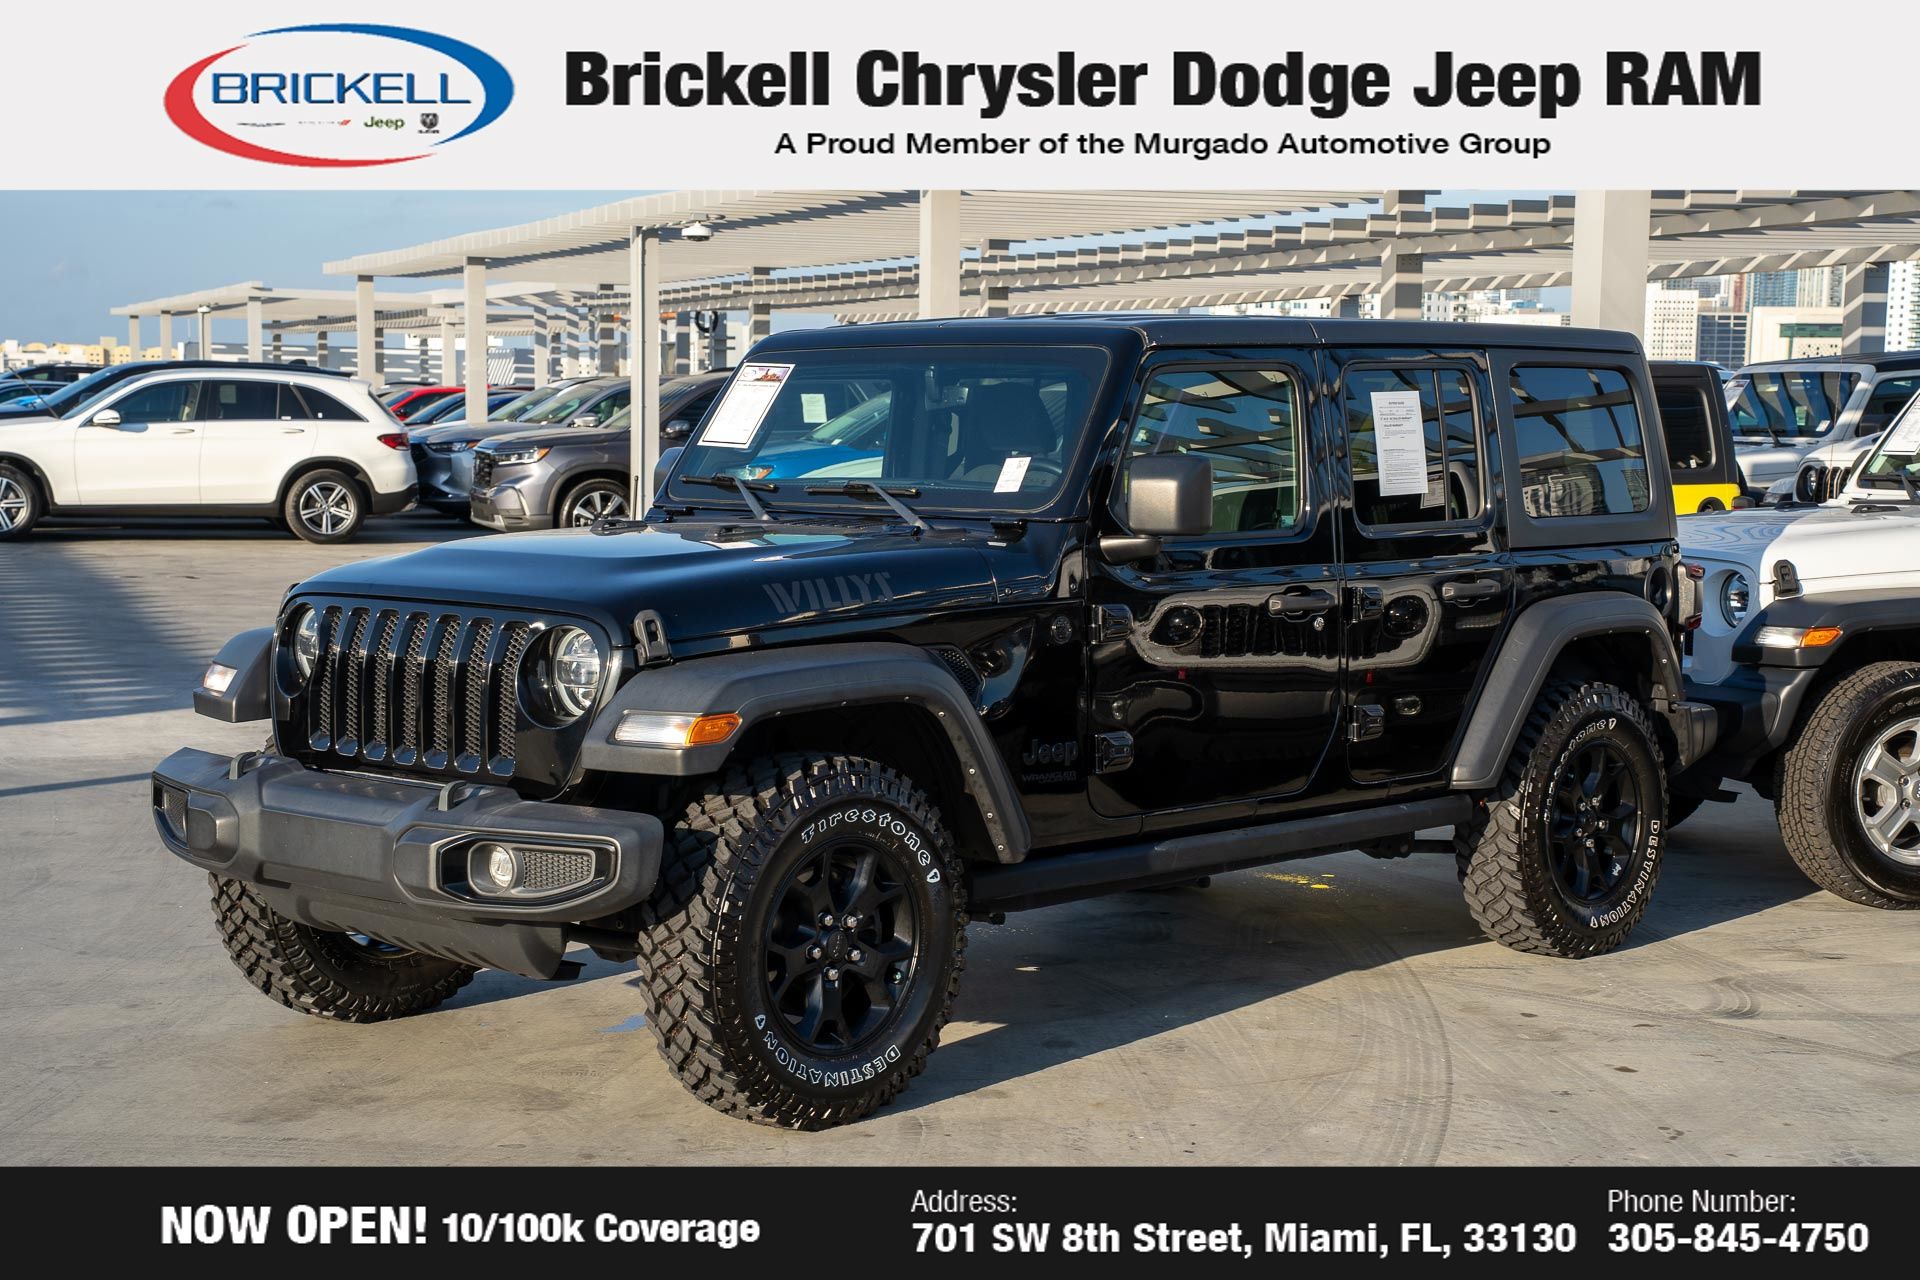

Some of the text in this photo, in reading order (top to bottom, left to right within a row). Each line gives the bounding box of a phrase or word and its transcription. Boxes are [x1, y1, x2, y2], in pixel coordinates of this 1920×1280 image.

[761, 572, 894, 613] WILLYS
[1023, 739, 1079, 766] Jeep
[802, 808, 931, 867] Firestone
[1600, 820, 1661, 928] DESTINATION
[763, 1031, 901, 1087] DESTINATION
